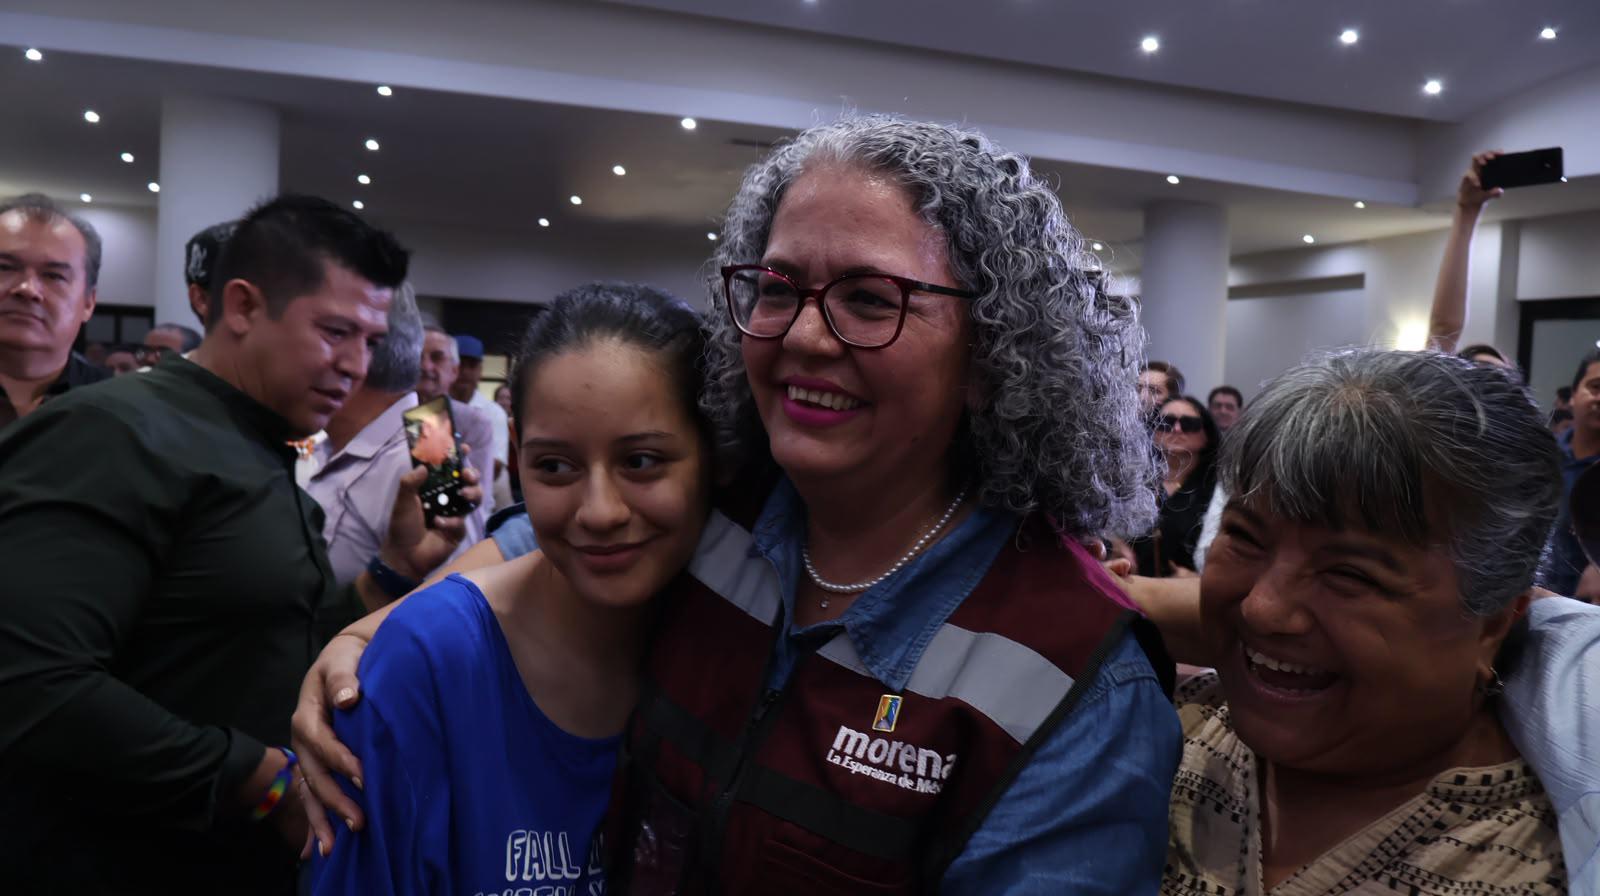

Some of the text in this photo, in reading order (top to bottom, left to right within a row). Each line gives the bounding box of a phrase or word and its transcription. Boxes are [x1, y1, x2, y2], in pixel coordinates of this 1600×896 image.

[826, 749, 840, 765] La
[841, 756, 897, 785] Esperanza
[898, 773, 914, 790] de
[505, 829, 581, 882] FALL
